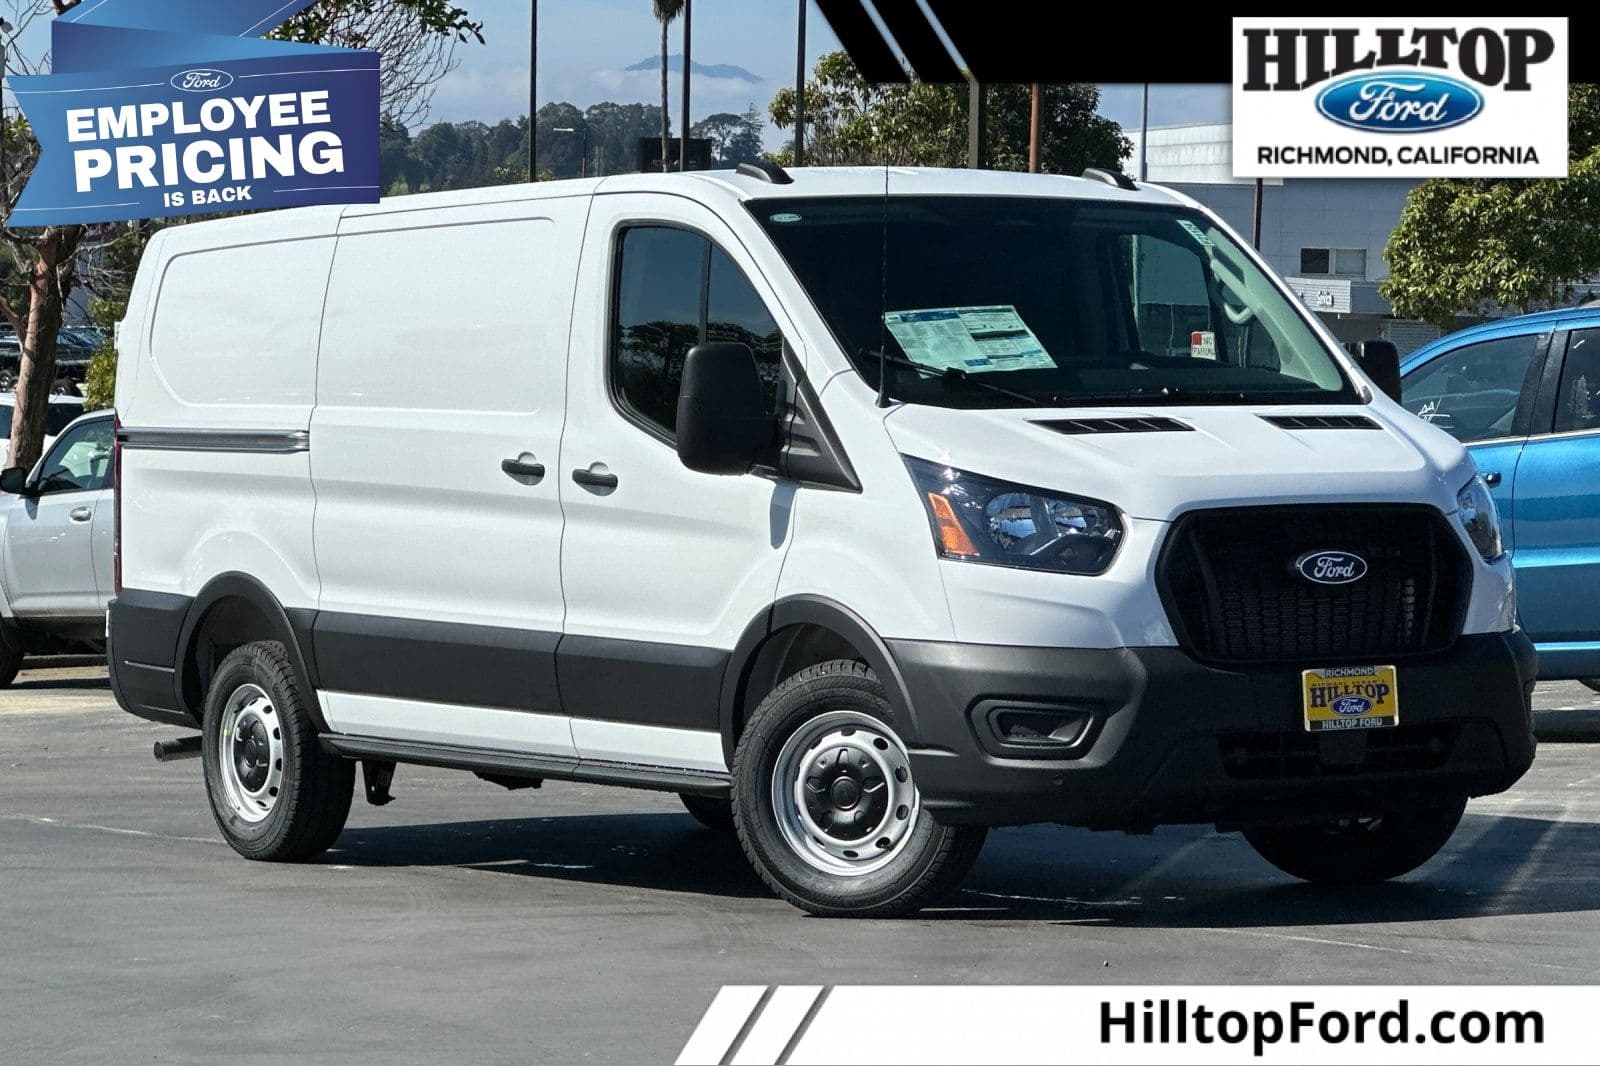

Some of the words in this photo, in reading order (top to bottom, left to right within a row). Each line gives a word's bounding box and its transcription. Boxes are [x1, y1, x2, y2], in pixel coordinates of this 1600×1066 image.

[1313, 556, 1356, 578] Ford
[1325, 667, 1374, 678] RICHMOND
[1309, 683, 1390, 708] HILLTOP
[1339, 698, 1365, 713] Ford
[1322, 718, 1358, 729] HILLTOP
[1360, 717, 1383, 728] FORD
